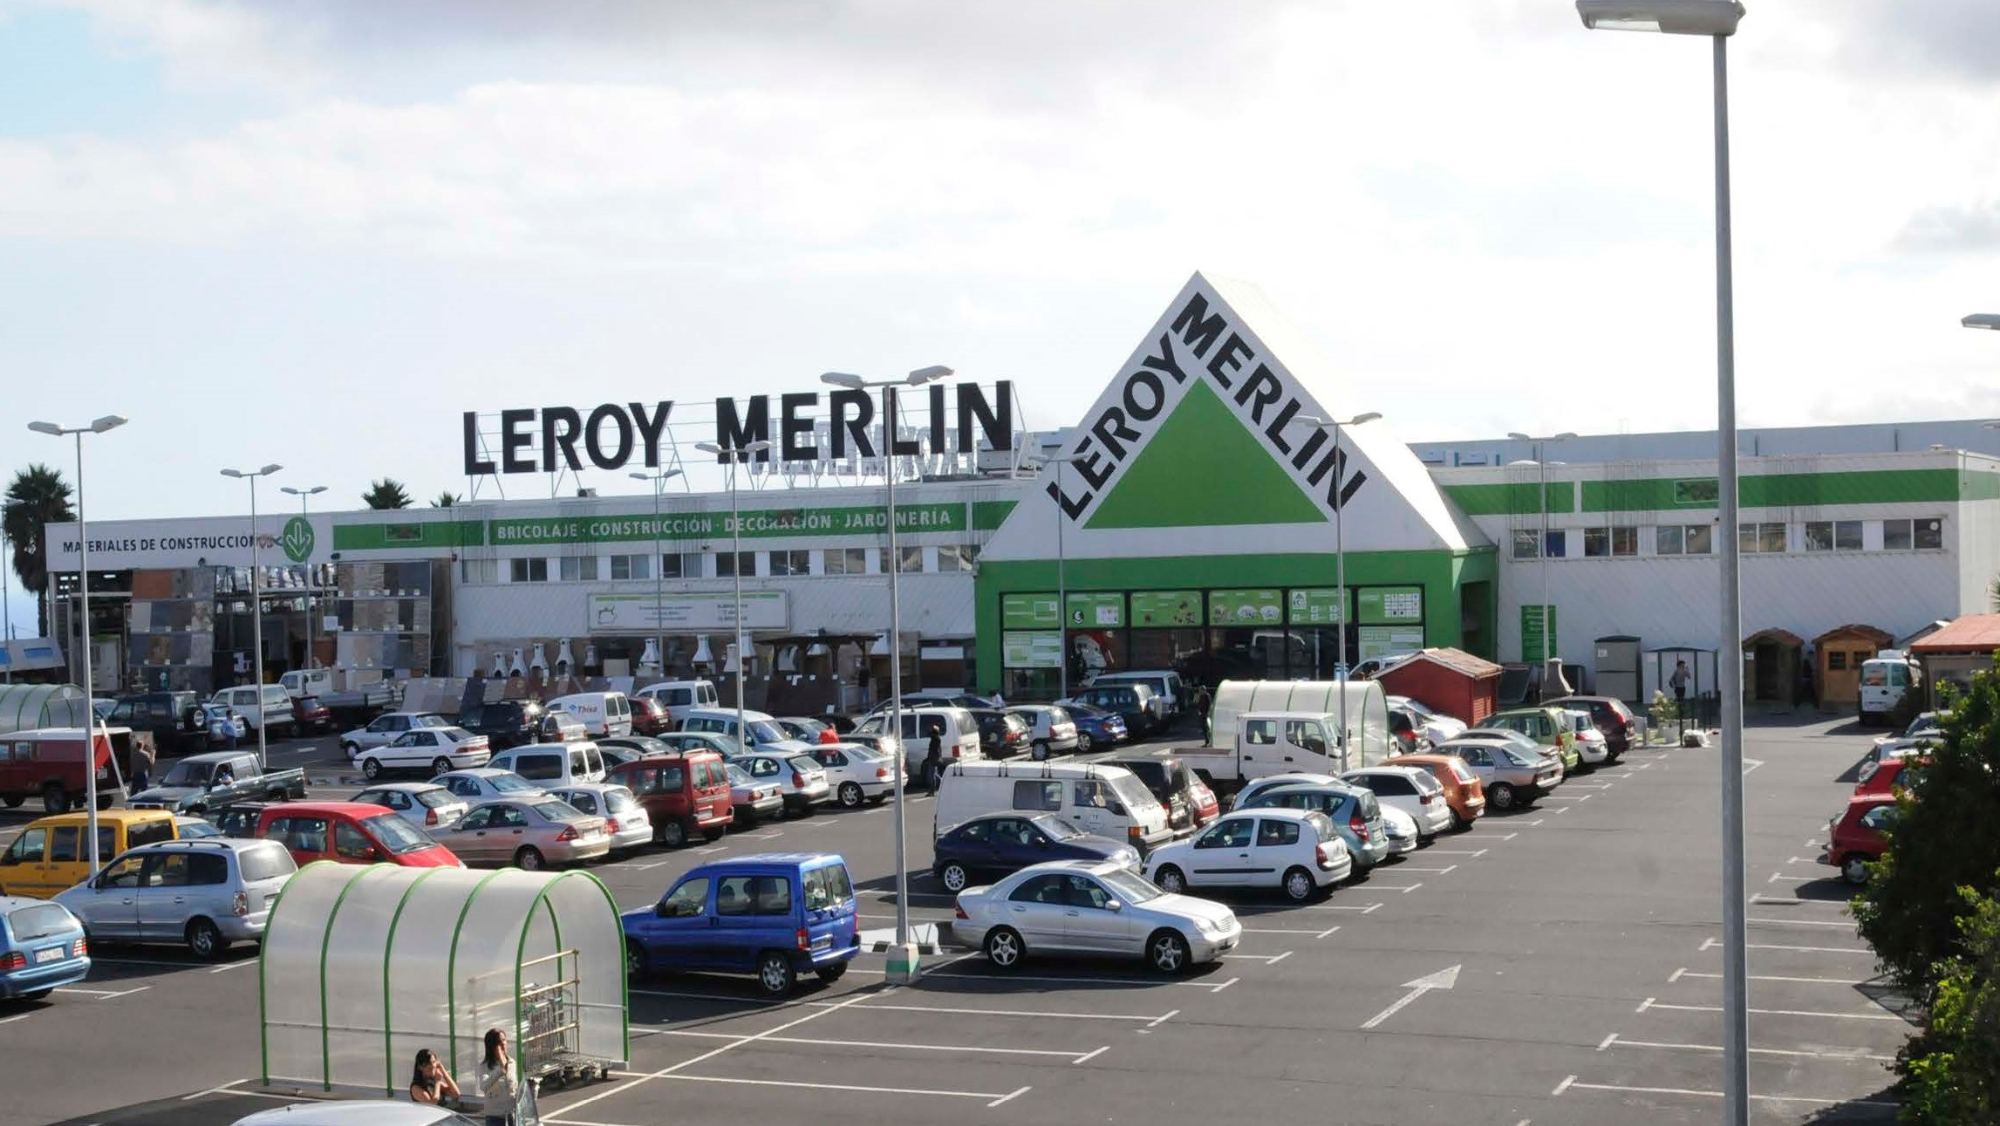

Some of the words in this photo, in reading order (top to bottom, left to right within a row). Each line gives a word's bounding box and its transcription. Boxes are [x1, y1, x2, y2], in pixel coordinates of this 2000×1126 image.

[463, 401, 673, 474] LEROY
[716, 380, 1011, 464] MERLIN
[1046, 332, 1187, 521] LEROY
[1170, 291, 1367, 512] MERLIN
[141, 538, 155, 550] DE
[497, 523, 577, 539] BRICOLAJE
[590, 515, 712, 536] CONSTRUCCIÓN
[724, 511, 831, 532] DECORACIÓN
[844, 507, 950, 527] JARDNERÍA
